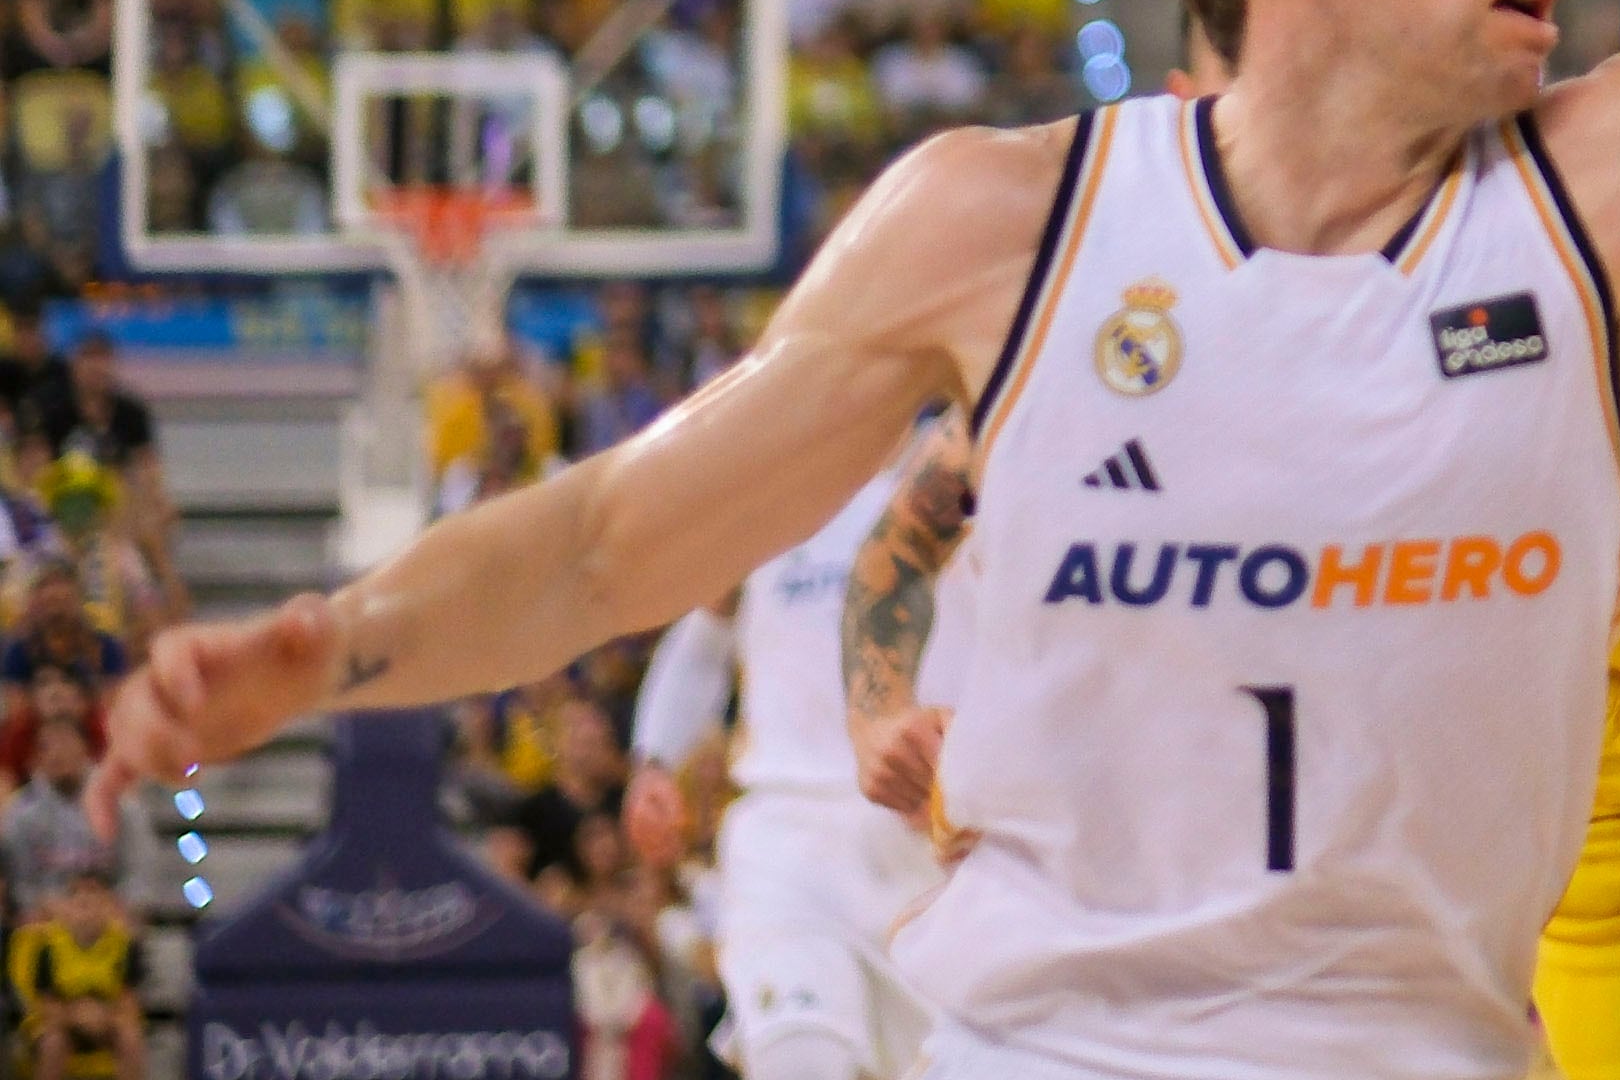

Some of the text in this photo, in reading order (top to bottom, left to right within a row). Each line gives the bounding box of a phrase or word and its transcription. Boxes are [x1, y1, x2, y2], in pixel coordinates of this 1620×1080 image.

[1446, 335, 1543, 370] endesa
[1042, 529, 1562, 610] AUTOHERO
[1233, 684, 1296, 872] 1
